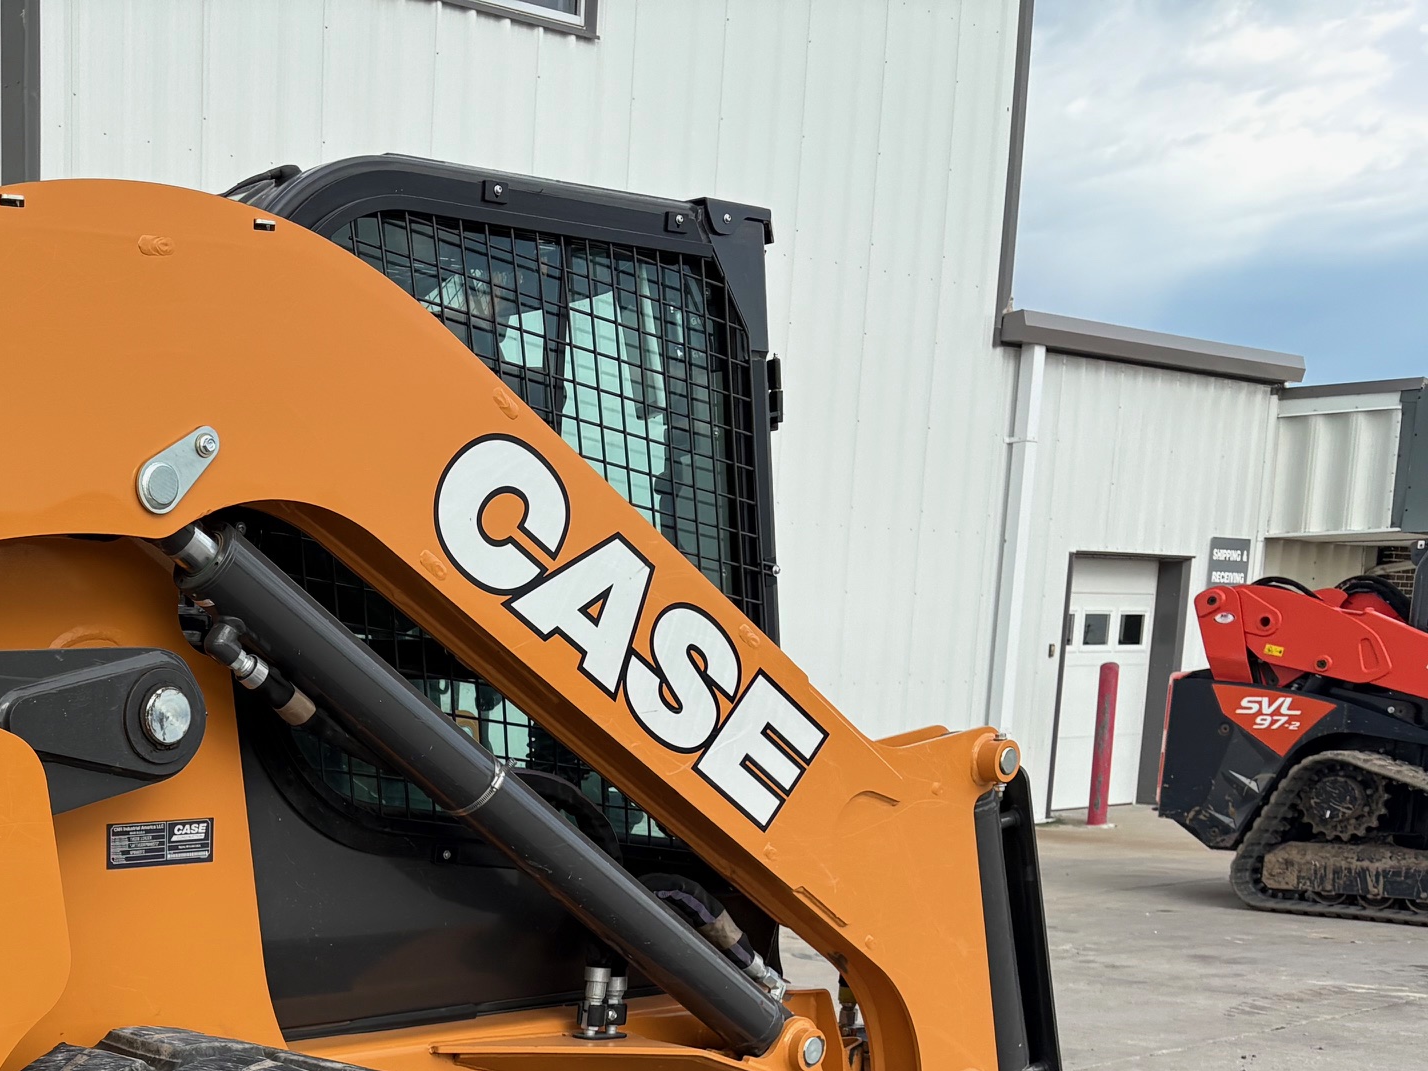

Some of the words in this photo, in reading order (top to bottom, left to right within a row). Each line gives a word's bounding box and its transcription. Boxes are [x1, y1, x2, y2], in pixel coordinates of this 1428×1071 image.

[1212, 548, 1241, 562] SHIPPING
[1211, 571, 1244, 583] RECEIVING
[433, 433, 829, 832] CASE
[1235, 696, 1302, 715] SVL
[1252, 715, 1301, 730] 97-2
[174, 822, 207, 835] CASE
